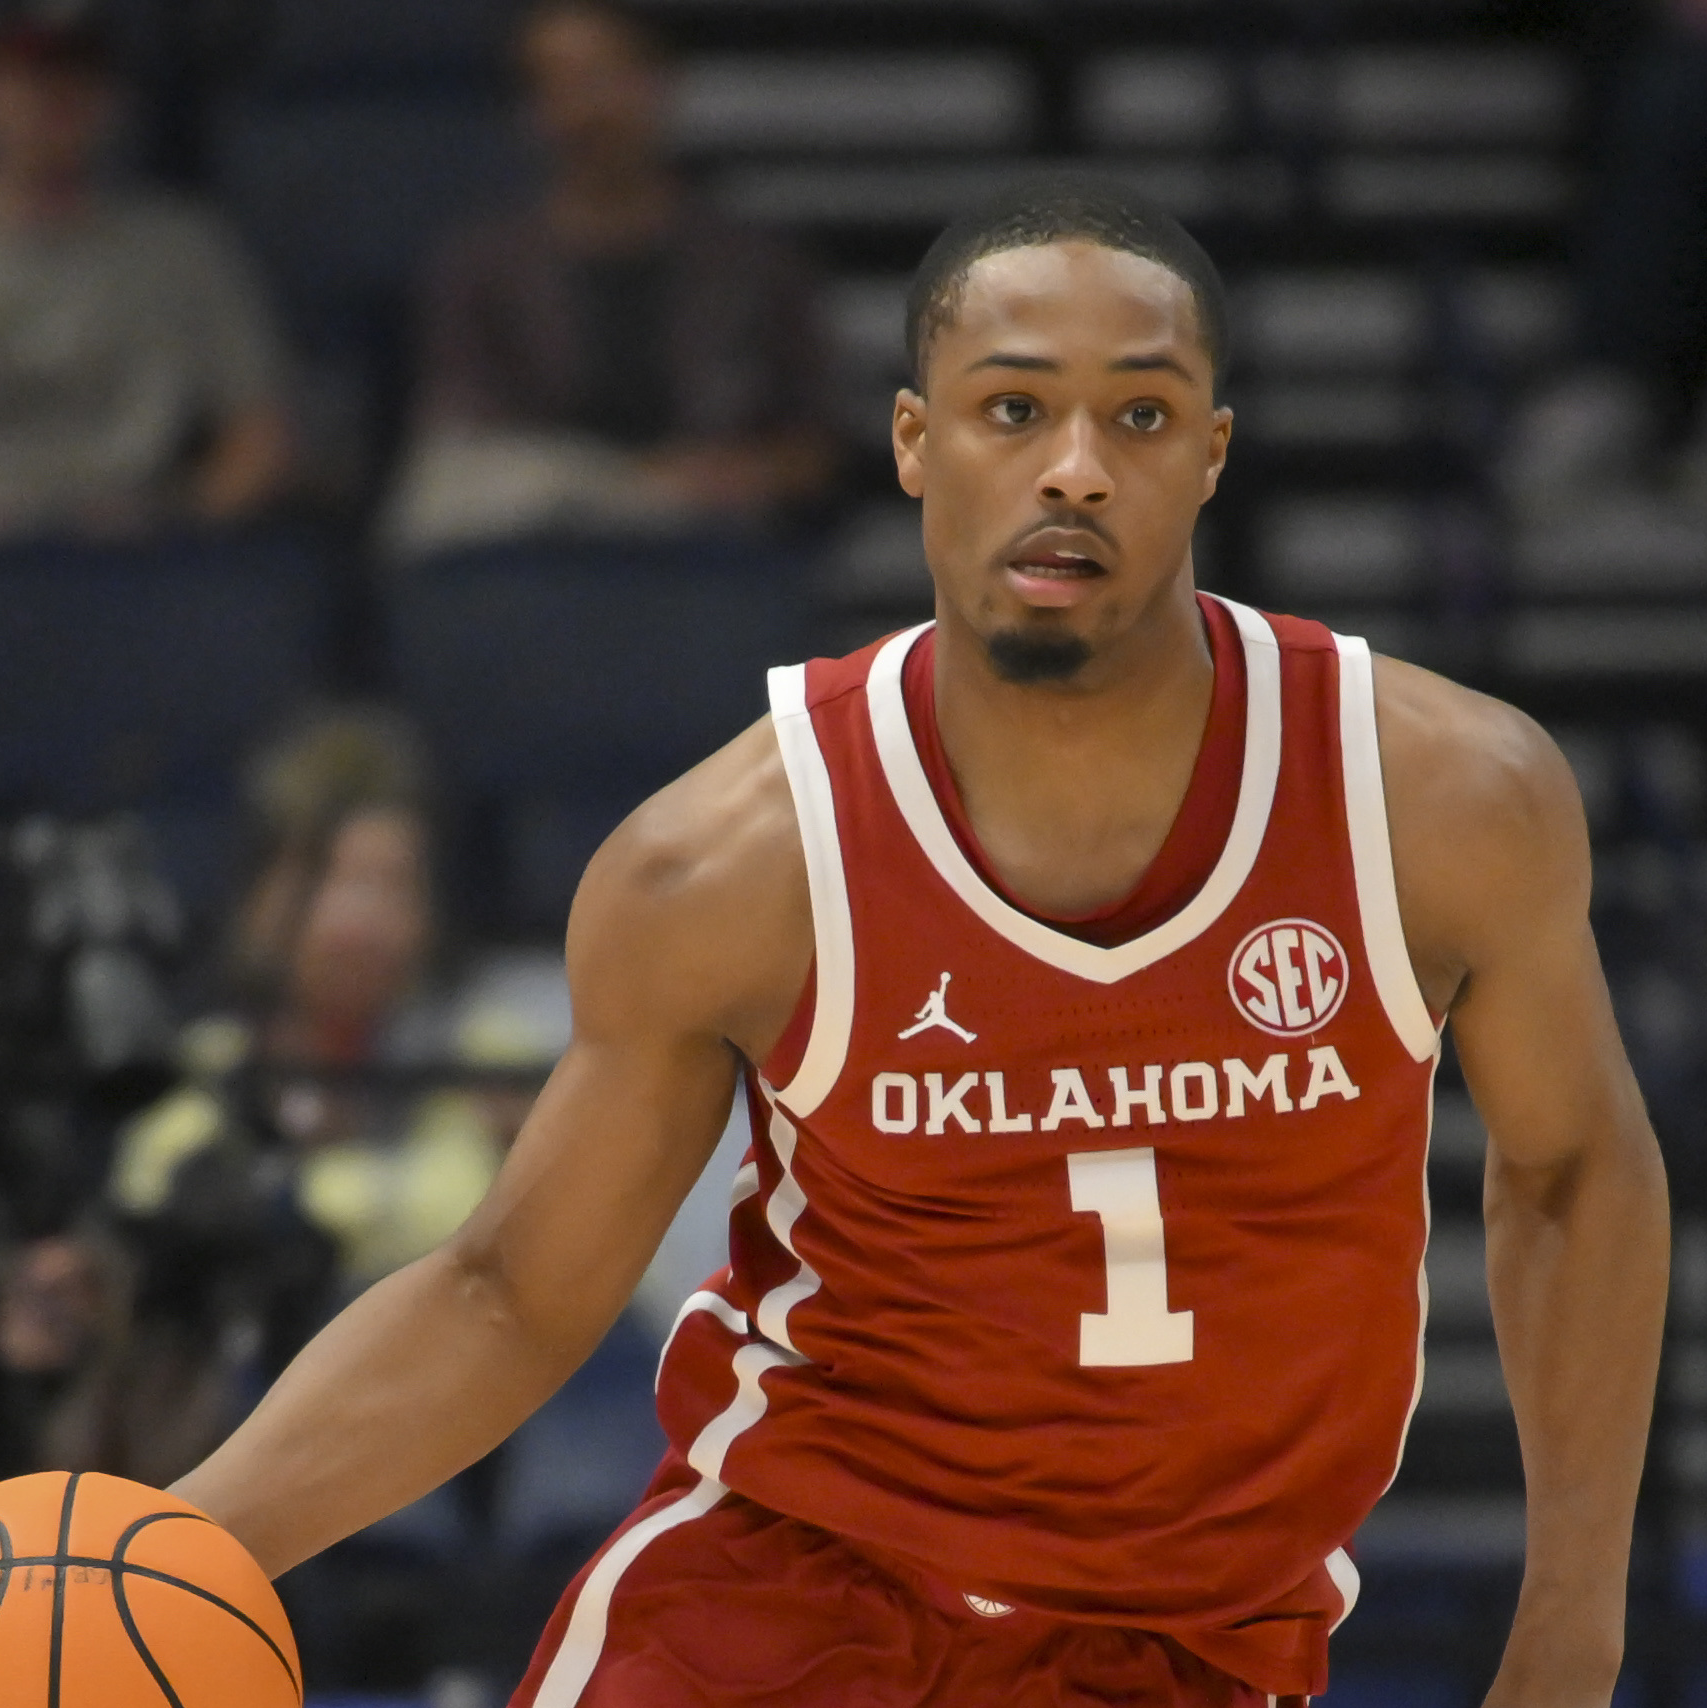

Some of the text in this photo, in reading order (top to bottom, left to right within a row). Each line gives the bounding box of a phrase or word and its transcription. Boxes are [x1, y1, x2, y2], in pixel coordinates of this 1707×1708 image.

[1238, 928, 1339, 1028] SEC
[871, 1045, 1360, 1135] OKLAHOMA
[1066, 1147, 1194, 1367] 1
